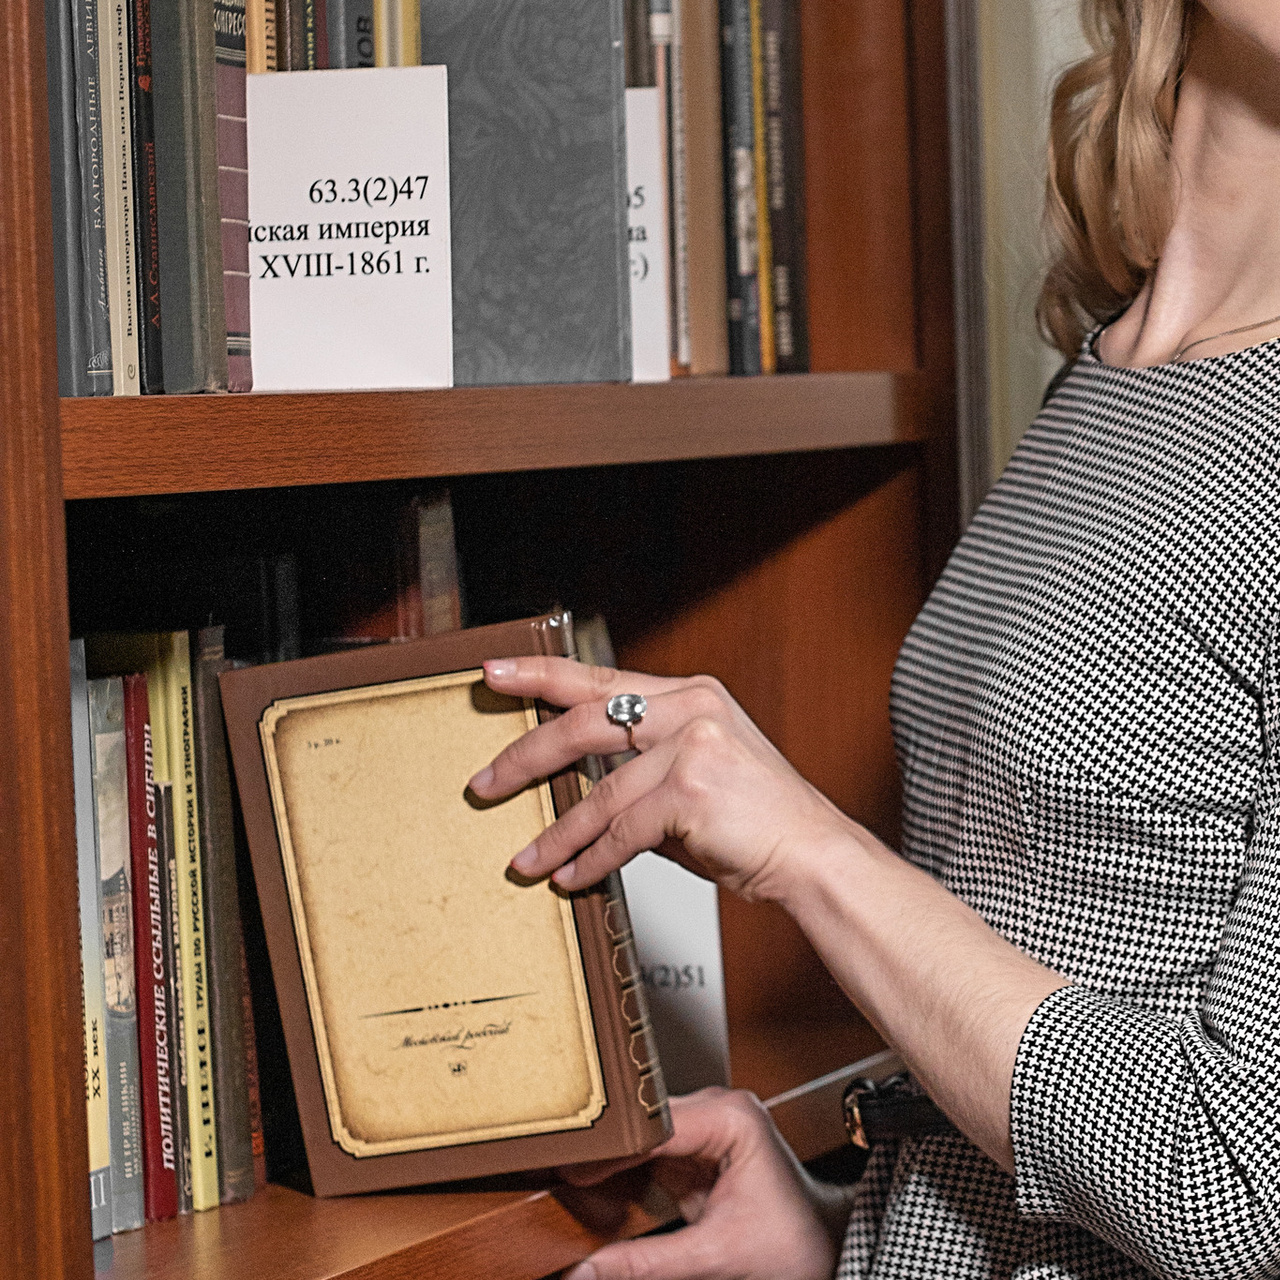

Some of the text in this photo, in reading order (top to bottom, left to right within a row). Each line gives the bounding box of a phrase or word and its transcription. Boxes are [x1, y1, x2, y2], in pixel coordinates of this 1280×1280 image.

[88, 77, 103, 230] БЛАГОРОДНЫЕ
[309, 176, 429, 207] 63.3(2)47
[121, 195, 133, 284] императора
[248, 219, 431, 245] ская империя
[259, 250, 430, 279] XVIII-1861 г.
[124, 290, 132, 335] Вызов
[179, 685, 192, 776] ЭТНОГРАФИИ
[185, 783, 192, 792] И
[185, 799, 196, 861] ИСТОРИИ
[188, 869, 200, 931] РУССКОЙ
[141, 722, 174, 1171] ПОЛИТИЧЕСКИЕ ССЫЛЬНЫЕ В СИБИРИ
[193, 937, 200, 955] ПО
[194, 962, 203, 1008] ТРУДЫ
[92, 1067, 100, 1098] XX
